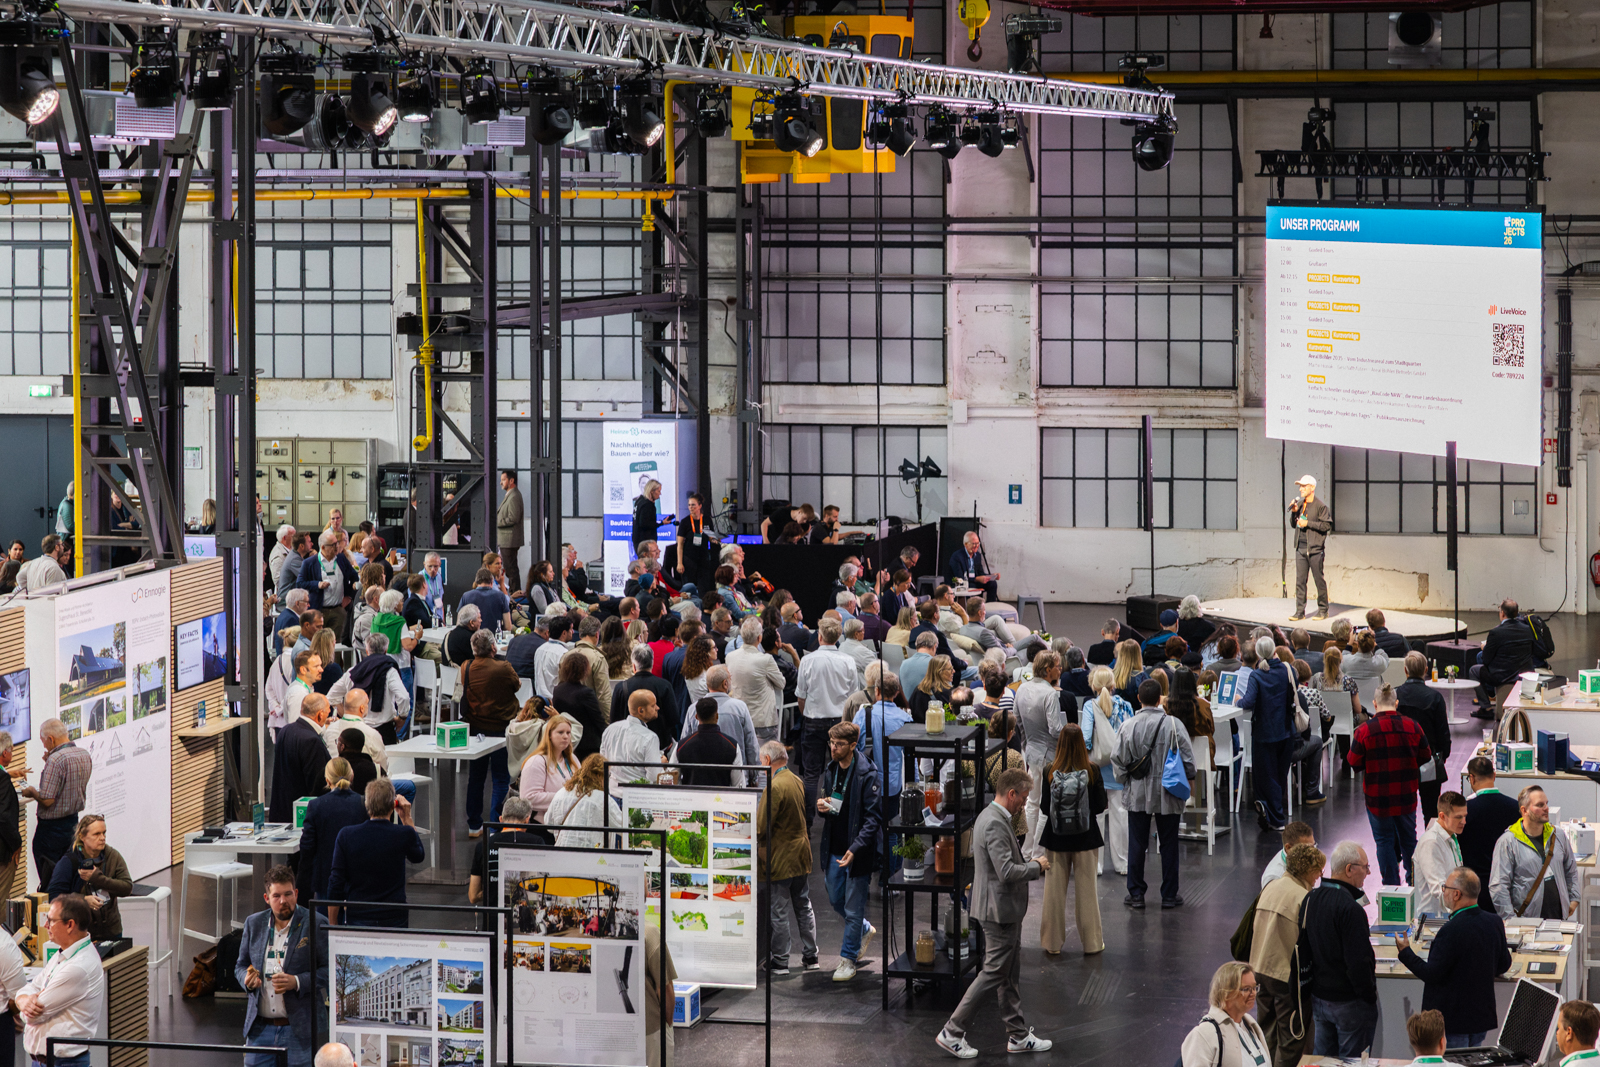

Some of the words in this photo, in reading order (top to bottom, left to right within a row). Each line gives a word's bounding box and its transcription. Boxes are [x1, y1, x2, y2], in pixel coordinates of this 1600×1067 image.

[1280, 218, 1308, 230] UNSER
[1310, 218, 1360, 232] PROGRAMM
[1511, 218, 1526, 227] PRO
[1504, 227, 1526, 236] JECTS
[1504, 236, 1512, 245] 26
[1500, 307, 1526, 316] LiveVoice
[144, 585, 166, 598] Ennogie
[188, 629, 198, 638] FACTS
